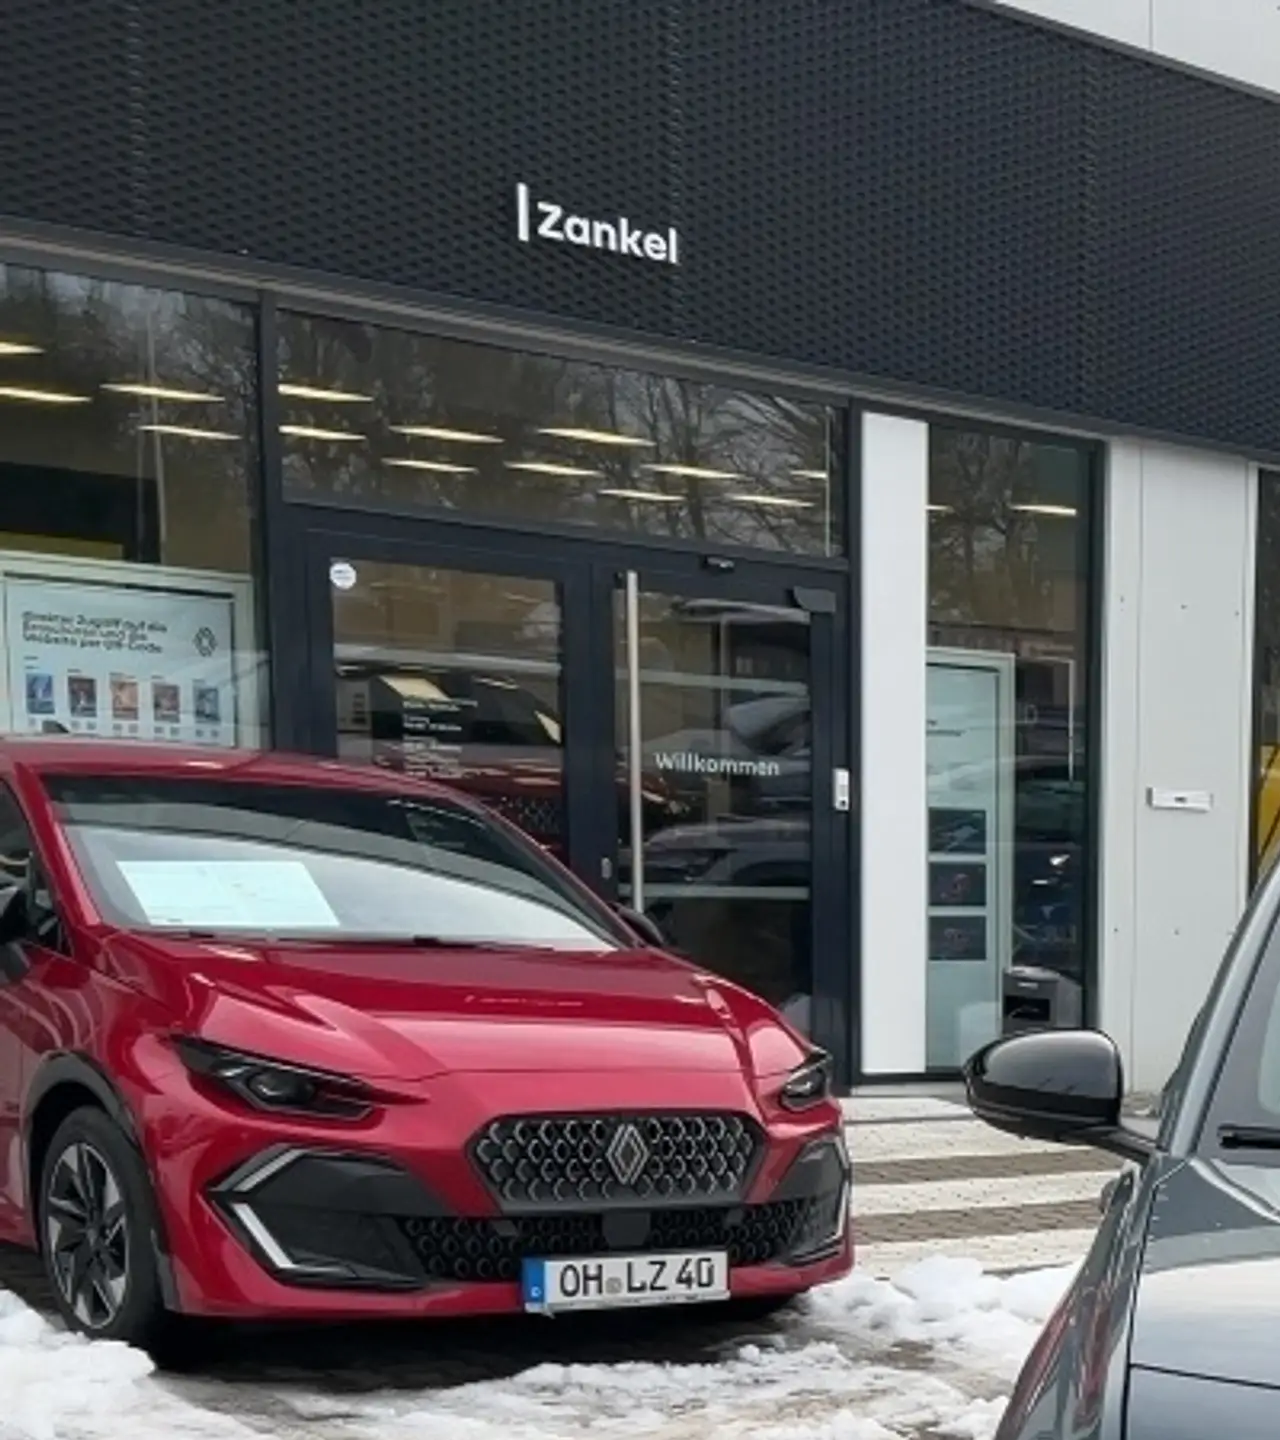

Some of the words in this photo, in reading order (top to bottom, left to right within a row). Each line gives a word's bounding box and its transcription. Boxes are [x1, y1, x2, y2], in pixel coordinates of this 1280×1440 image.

[653, 752, 781, 777] Willkommen
[559, 1263, 603, 1298] OH
[626, 1260, 669, 1294] LZ
[674, 1256, 715, 1290] 40
